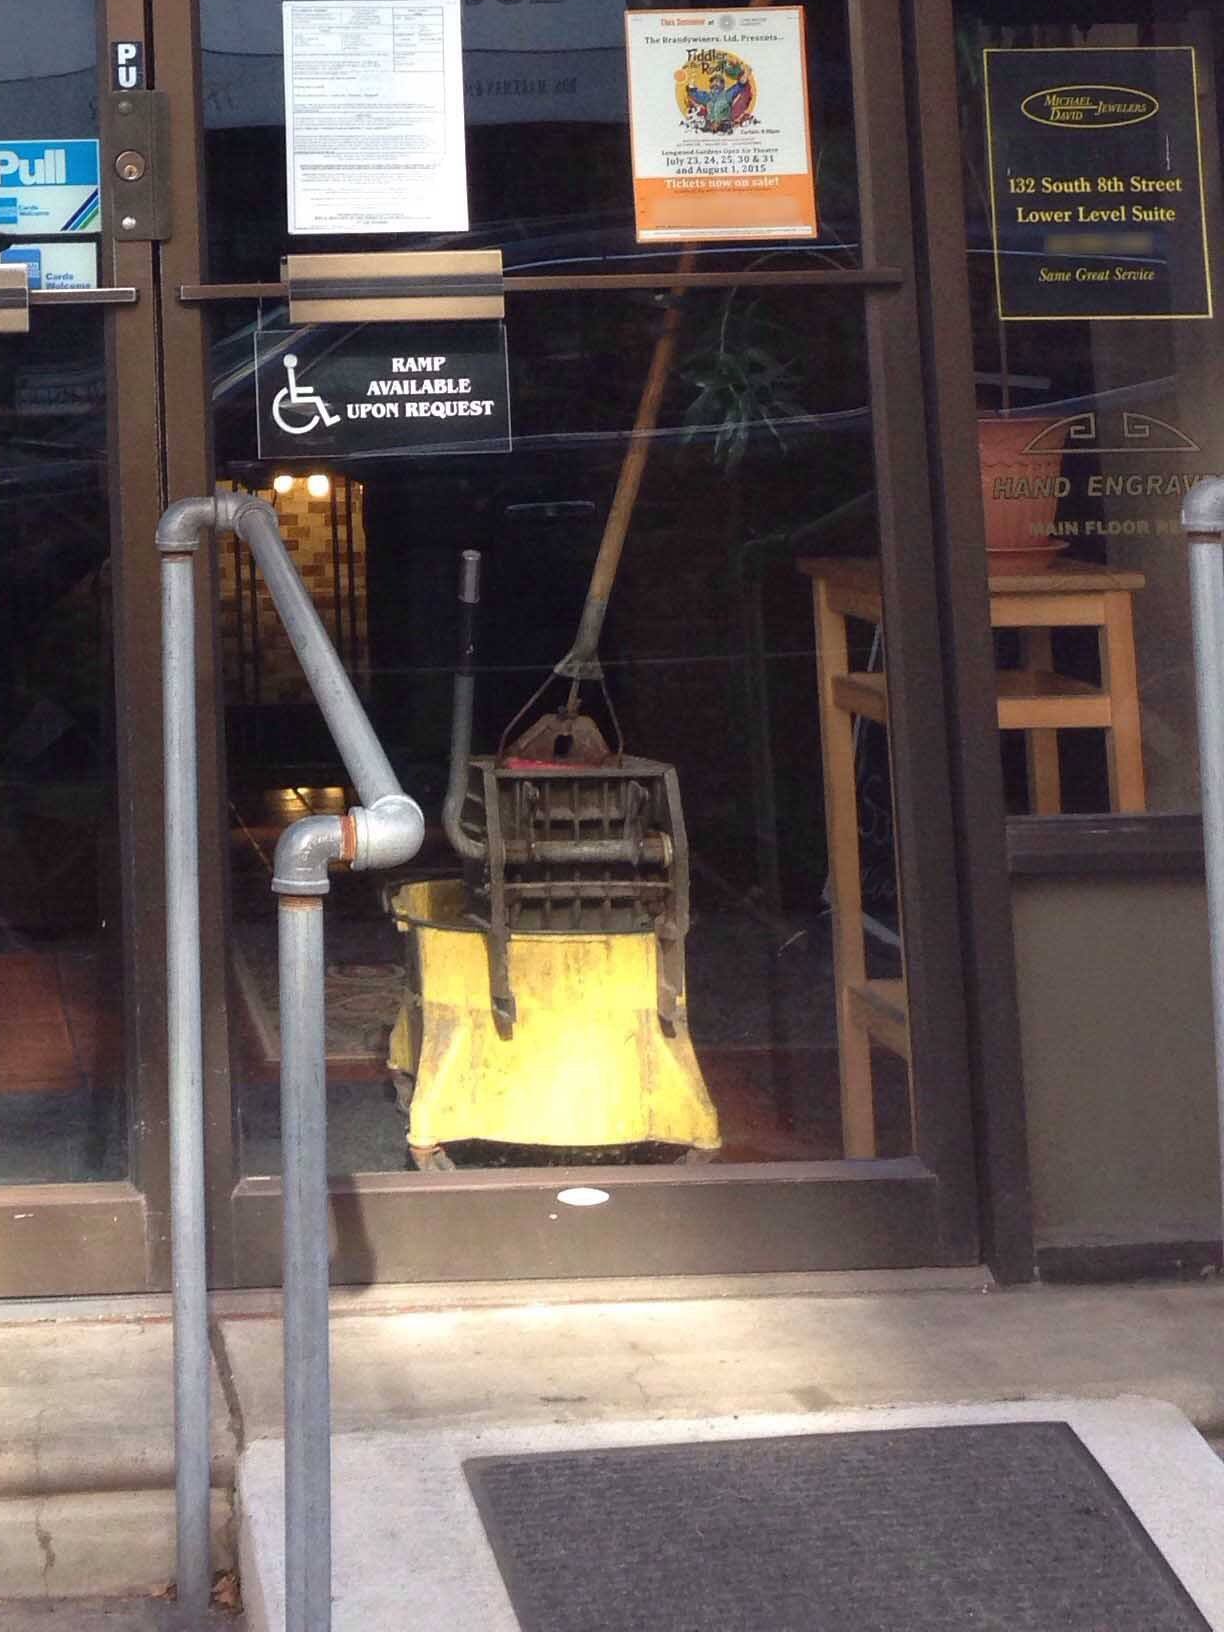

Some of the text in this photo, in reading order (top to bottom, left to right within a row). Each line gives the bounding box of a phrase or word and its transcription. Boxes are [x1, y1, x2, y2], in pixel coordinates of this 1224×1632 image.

[686, 48, 727, 62] Fiddler
[1043, 94, 1093, 106] MICHAEL
[1094, 100, 1147, 116] JEWELERS
[1049, 109, 1084, 121] DAVID
[667, 157, 684, 167] July
[676, 166, 693, 174] and
[696, 165, 728, 176] August
[742, 164, 767, 173] 2015
[665, 179, 707, 189] Tickets
[1008, 175, 1183, 194] 132 South 8th Street
[1016, 204, 1176, 223] Lower Level Suite
[1038, 267, 1156, 283] Same Great Service
[391, 356, 446, 372] RAMP
[366, 378, 471, 396] AVAILABLE
[347, 400, 495, 420] UPON REQUEST
[992, 473, 1207, 500] HAND ENGRAV
[1031, 520, 1079, 536] MAIN
[1085, 520, 1150, 536] FLOOR
